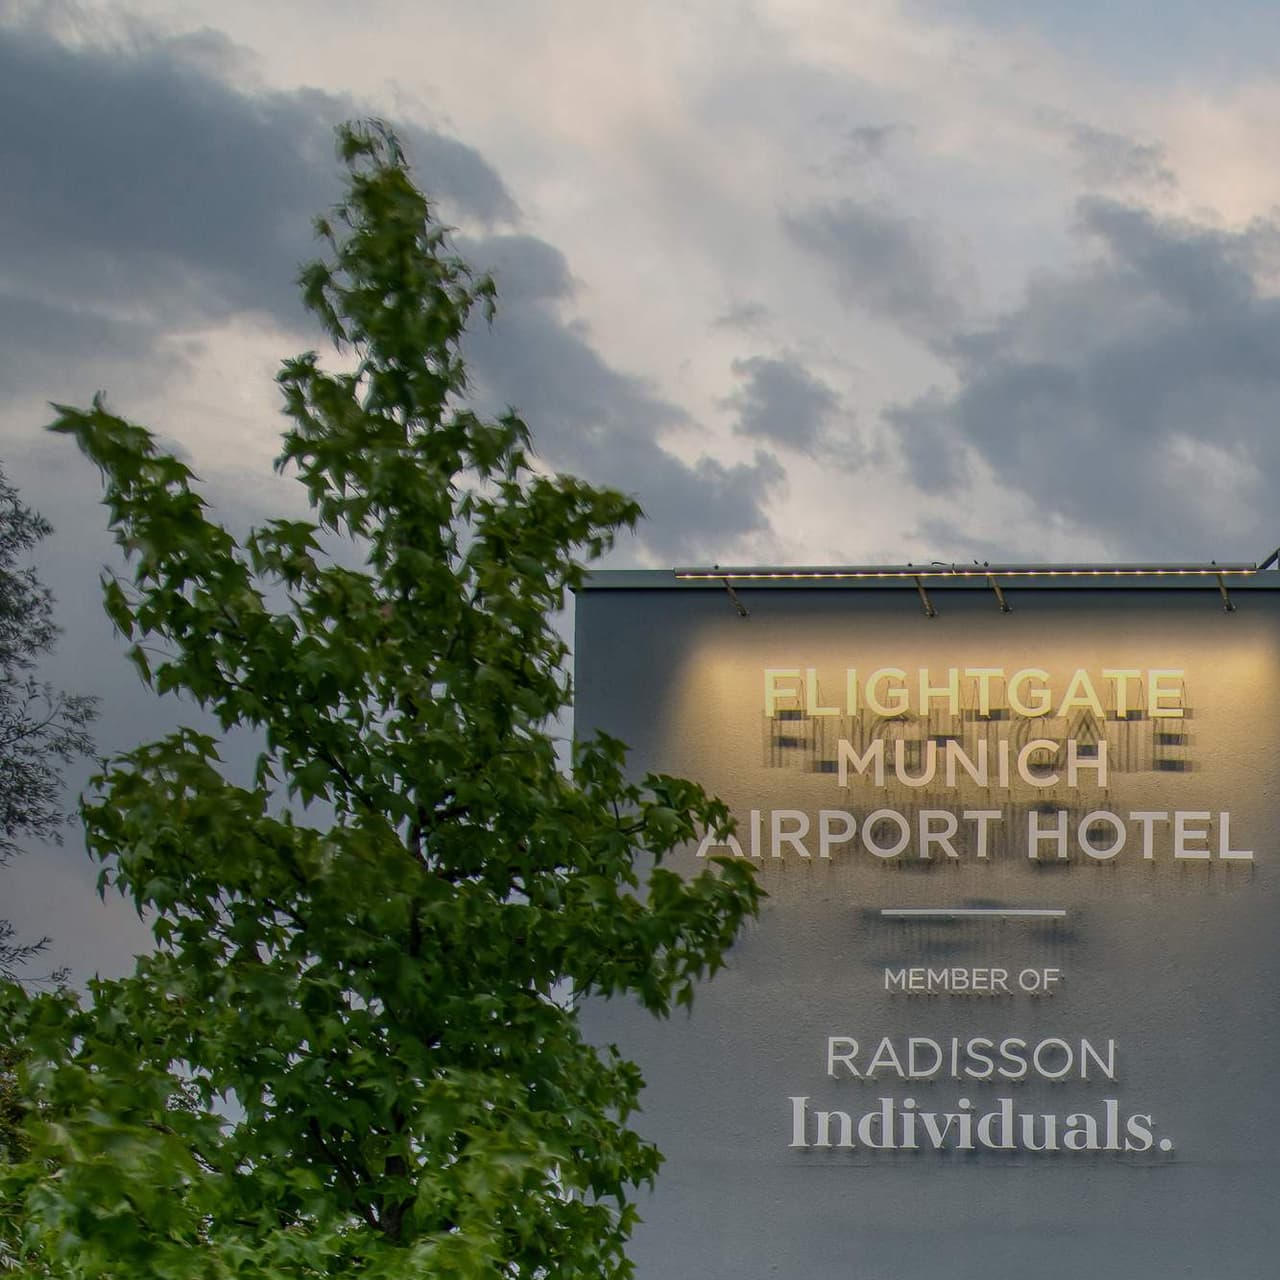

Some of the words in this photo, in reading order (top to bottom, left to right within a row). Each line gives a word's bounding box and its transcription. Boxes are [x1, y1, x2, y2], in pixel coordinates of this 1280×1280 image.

[764, 667, 1186, 718] FLIGHTGATE
[837, 738, 1108, 788] MUNICH
[695, 809, 1002, 859] AIRPORT
[1027, 809, 1254, 860] HOTEL
[883, 967, 1009, 991] MEMBER
[1018, 968, 1061, 992] OF
[826, 1036, 1117, 1080] RADISSON
[787, 1096, 1174, 1153] Individuals.
